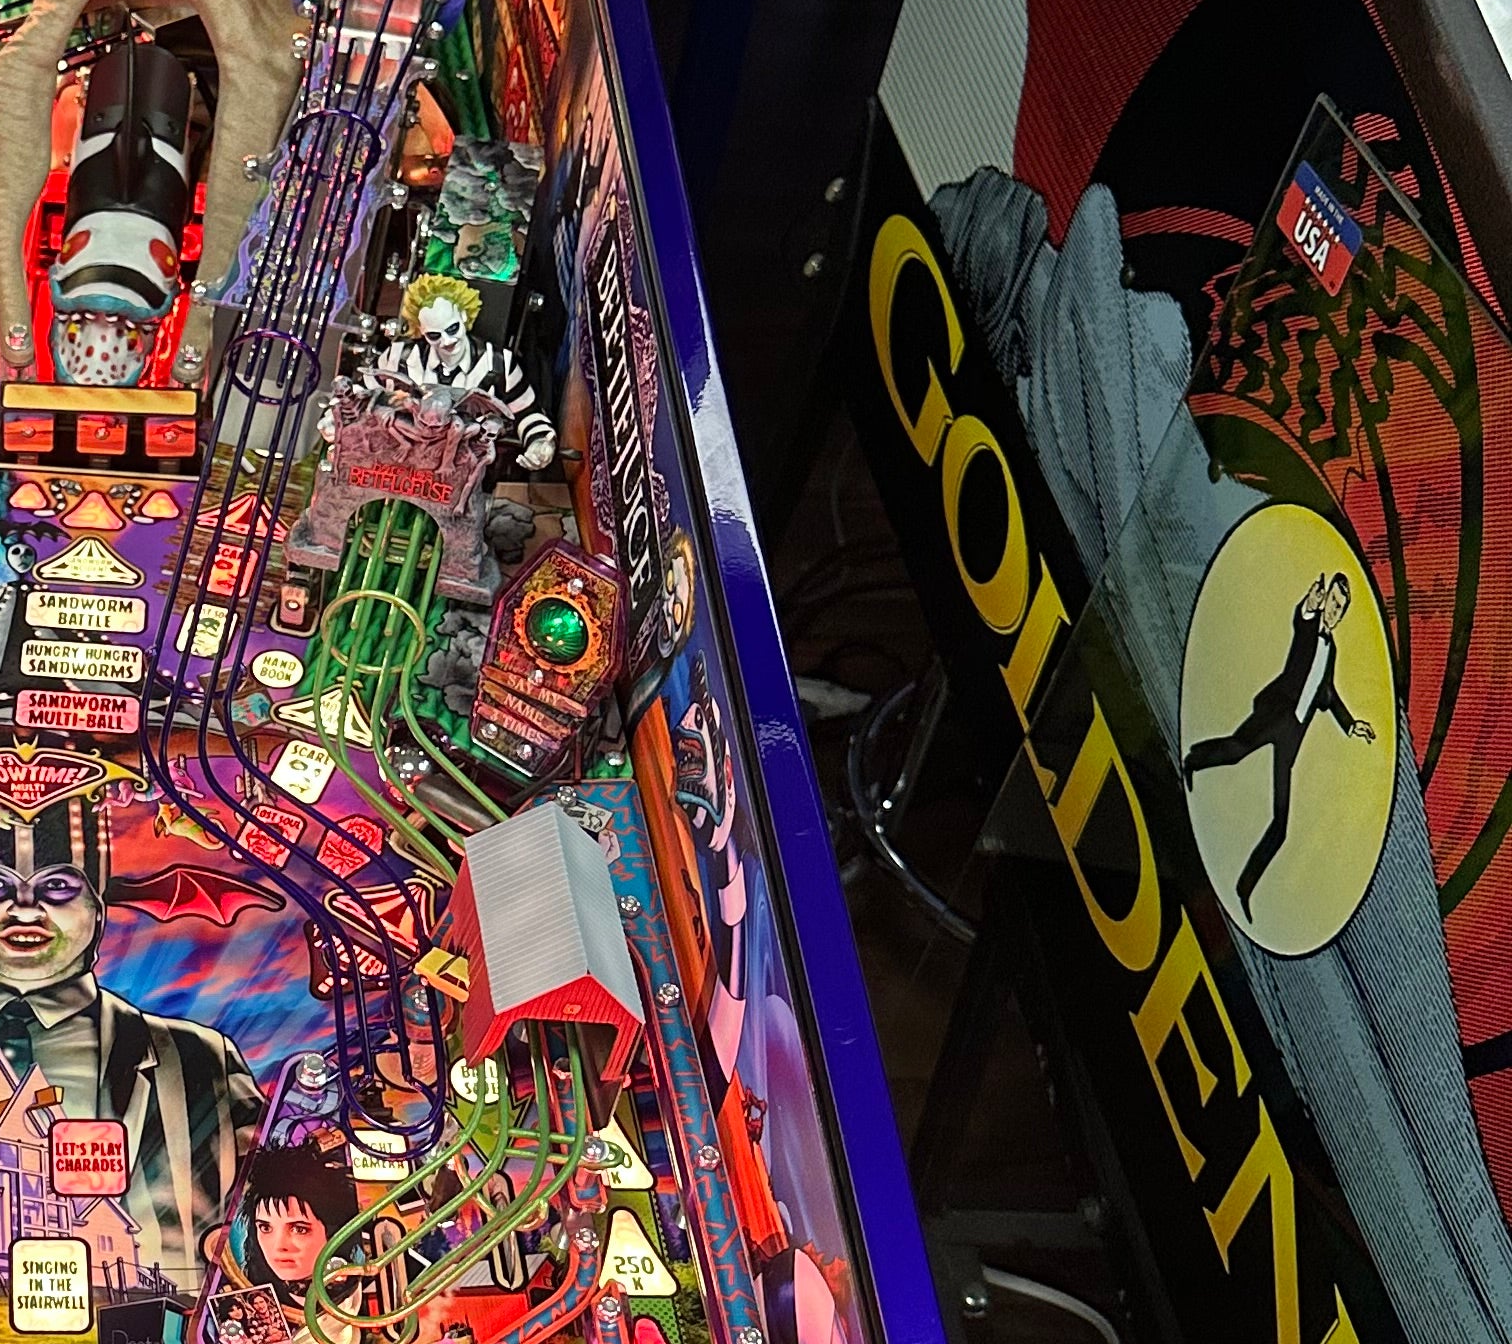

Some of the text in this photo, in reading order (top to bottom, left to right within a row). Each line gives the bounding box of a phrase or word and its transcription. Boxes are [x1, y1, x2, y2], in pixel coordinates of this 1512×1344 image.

[1294, 210, 1331, 273] USA
[595, 241, 656, 613] BEETLEJUICE
[349, 466, 454, 505] BETELGEUSE
[39, 594, 134, 613] SANDWORM
[58, 612, 112, 628] BATTLE
[25, 643, 139, 663] HUNGRY HUNGRY
[263, 654, 297, 672] HAND
[28, 659, 134, 679] SANDWORMS
[260, 666, 293, 682] BOOK
[507, 674, 561, 706] SAY MY
[29, 693, 127, 713] SANDWORM
[505, 693, 545, 724] NAME
[28, 710, 124, 731] MULTI-BALL
[501, 712, 545, 744] TIMES
[10, 782, 46, 793] MULTI
[55, 1141, 123, 1158] LET'S PLAY
[55, 1156, 125, 1175] CHARADES
[22, 1259, 79, 1277] SINGING
[614, 1256, 655, 1275] 250
[28, 1276, 73, 1293] IN THE
[17, 1292, 87, 1312] STAIRWELL
